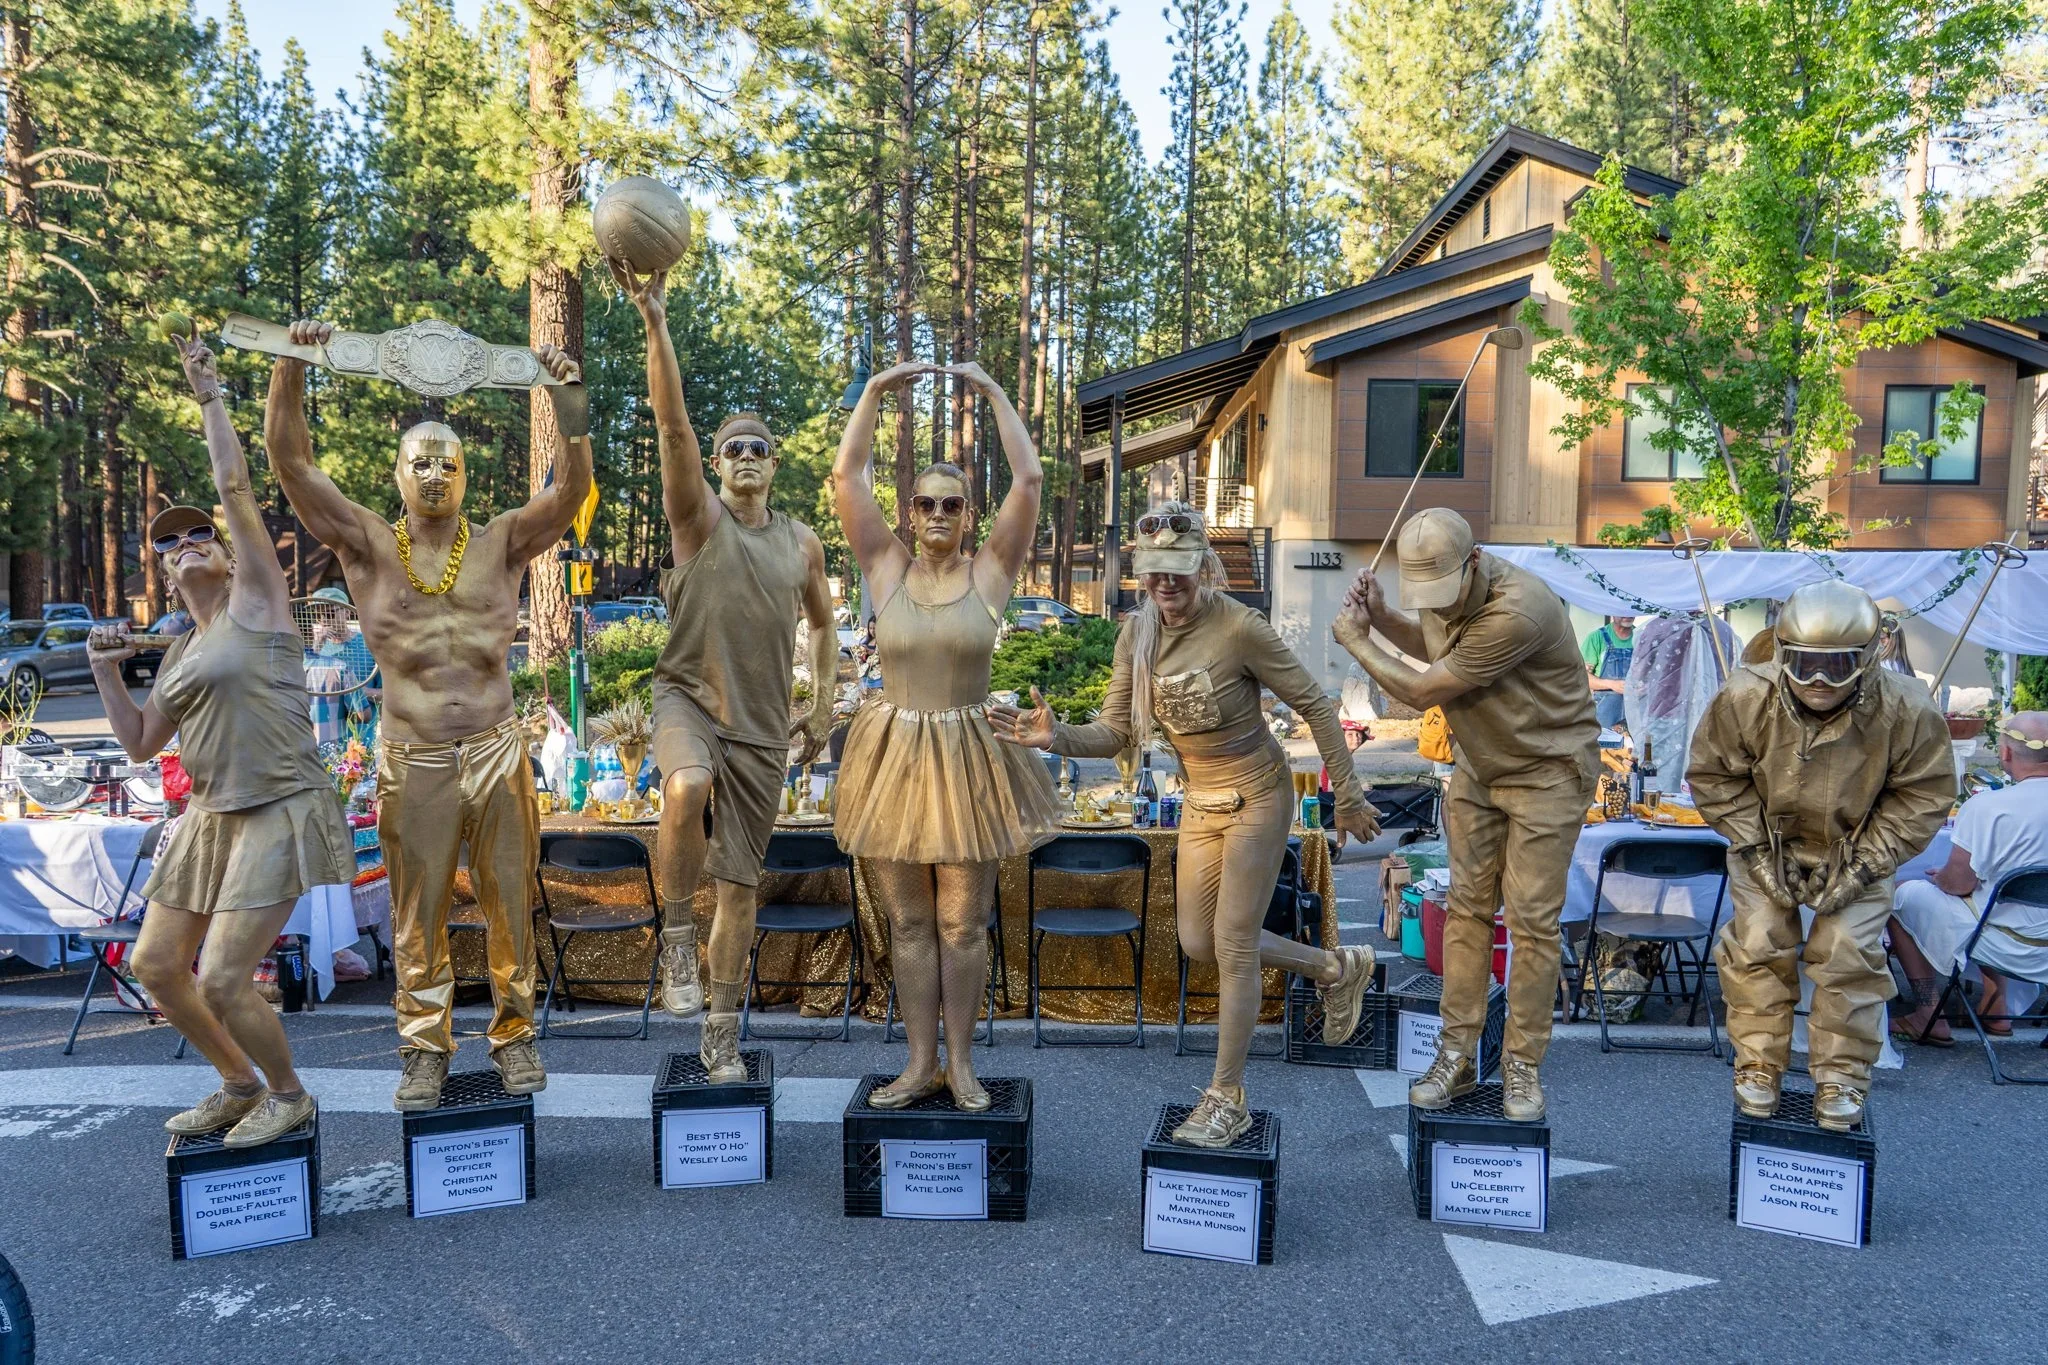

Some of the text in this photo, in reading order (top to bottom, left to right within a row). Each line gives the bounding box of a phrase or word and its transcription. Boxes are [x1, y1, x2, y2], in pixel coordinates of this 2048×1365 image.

[1310, 552, 1341, 566] 1133
[1410, 1020, 1435, 1031] TAHOE
[1411, 1048, 1435, 1057] BRIAN
[686, 1131, 741, 1141] BEST STHS
[428, 1137, 510, 1154] BARTON'S BEST
[719, 1143, 727, 1151] O
[444, 1151, 494, 1163] SECURITY
[679, 1155, 748, 1165] WESLEY LONG
[910, 1150, 957, 1160] DOROTHY
[1453, 1155, 1523, 1167] EDGEWOOD'S
[447, 1162, 492, 1174] OFFICER
[895, 1160, 973, 1171] FARNON'S BEST
[1756, 1156, 1846, 1179] ECHO SUMMIT'S
[442, 1173, 498, 1187] CHRISTIAN
[907, 1173, 961, 1182] BALLERINA
[1473, 1169, 1503, 1179] MOST
[1757, 1168, 1803, 1184] SLALOM
[204, 1173, 287, 1194] ZEPHYR COVE
[905, 1184, 964, 1194] KATIE LONG
[1159, 1180, 1248, 1199] LAKE TAHOE MOST
[1451, 1181, 1525, 1193] UN-CELEBRITY
[209, 1186, 283, 1205] TENNIS BEST
[448, 1185, 493, 1198] MUNSON
[1769, 1183, 1830, 1201] CHAMPION
[1175, 1193, 1230, 1208] UNTRAINED
[1467, 1194, 1509, 1204] GOLFER
[1760, 1194, 1839, 1216] JASON ROLFE
[196, 1195, 298, 1219] DOUBLE-FAULTER
[1168, 1203, 1235, 1220] MARATHONER
[1444, 1205, 1532, 1218] MATHEW PIERCE
[209, 1209, 287, 1230] SARA PIERCE
[1157, 1213, 1247, 1233] NATASHA MUNSON
